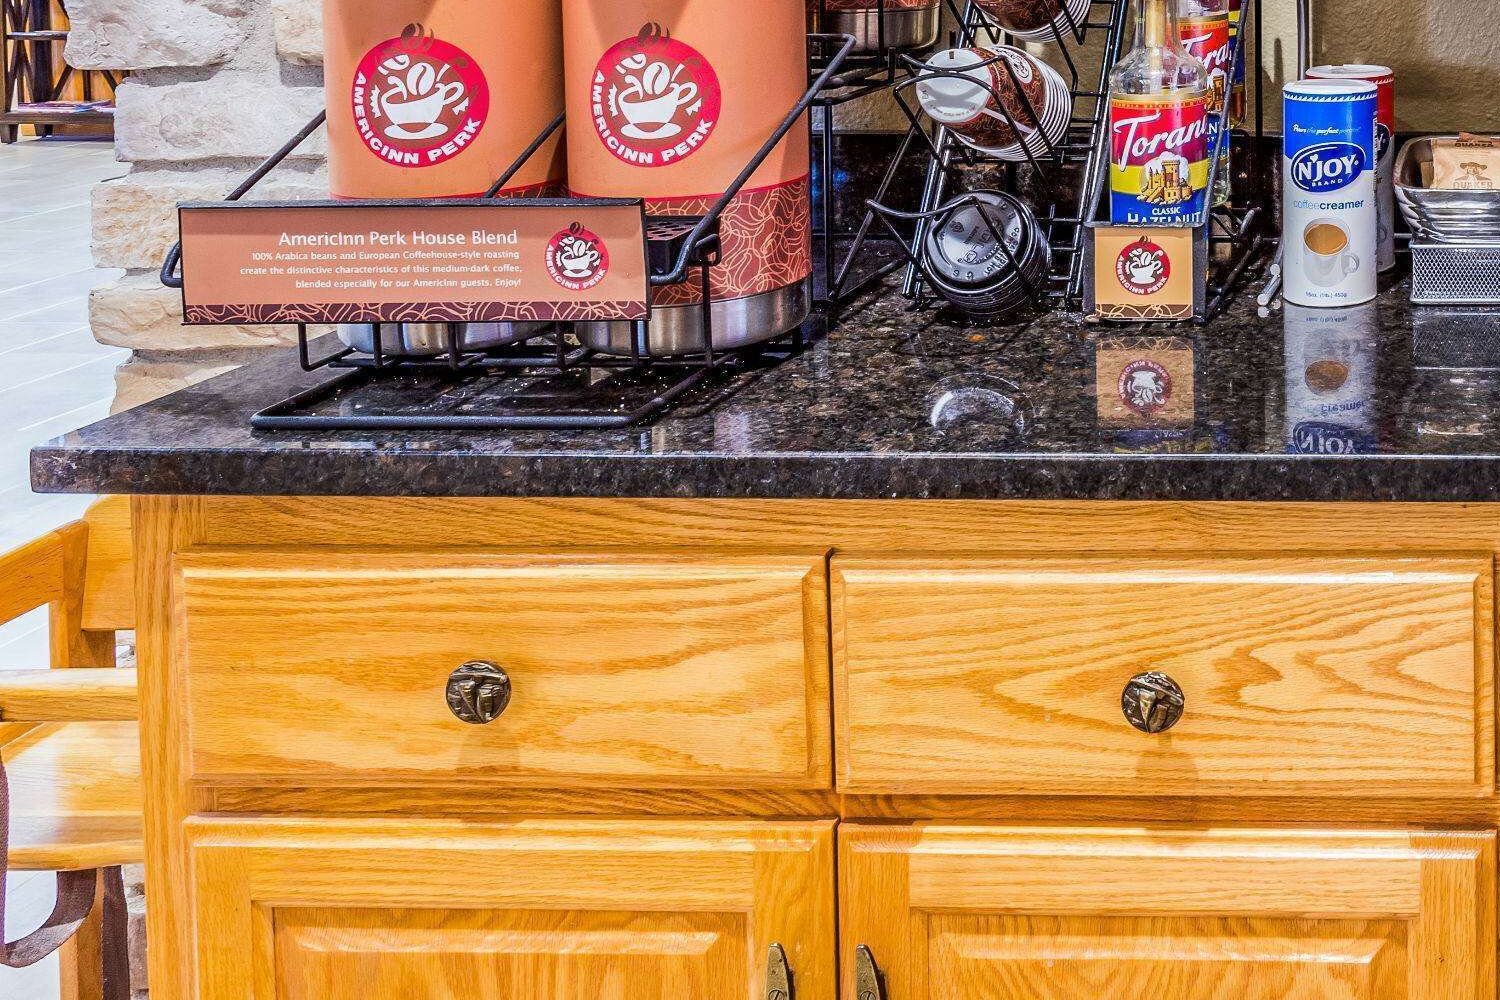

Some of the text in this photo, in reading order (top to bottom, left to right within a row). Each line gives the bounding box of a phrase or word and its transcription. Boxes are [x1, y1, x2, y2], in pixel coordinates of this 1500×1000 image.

[353, 71, 482, 164] AMERICINN PERK
[592, 70, 714, 164] AMERICINN PERK
[1311, 178, 1343, 187] BRAND
[1151, 206, 1181, 216] CLASSIC
[278, 230, 518, 247] AmericInn Perk House Blend
[252, 250, 520, 262] 100% Arabica beans and European Coffeehouse-style roasting
[240, 264, 523, 275] create the distinctive characteristics of this medium-dark coffee,
[545, 244, 606, 290] AMERICINN PERK
[1116, 254, 1168, 295] AMERICINN PERK
[295, 280, 332, 289] blended
[333, 279, 377, 290] especially
[379, 279, 394, 288] for
[395, 280, 410, 288] our
[460, 278, 492, 289] guests.
[494, 277, 521, 289] Enjoy!
